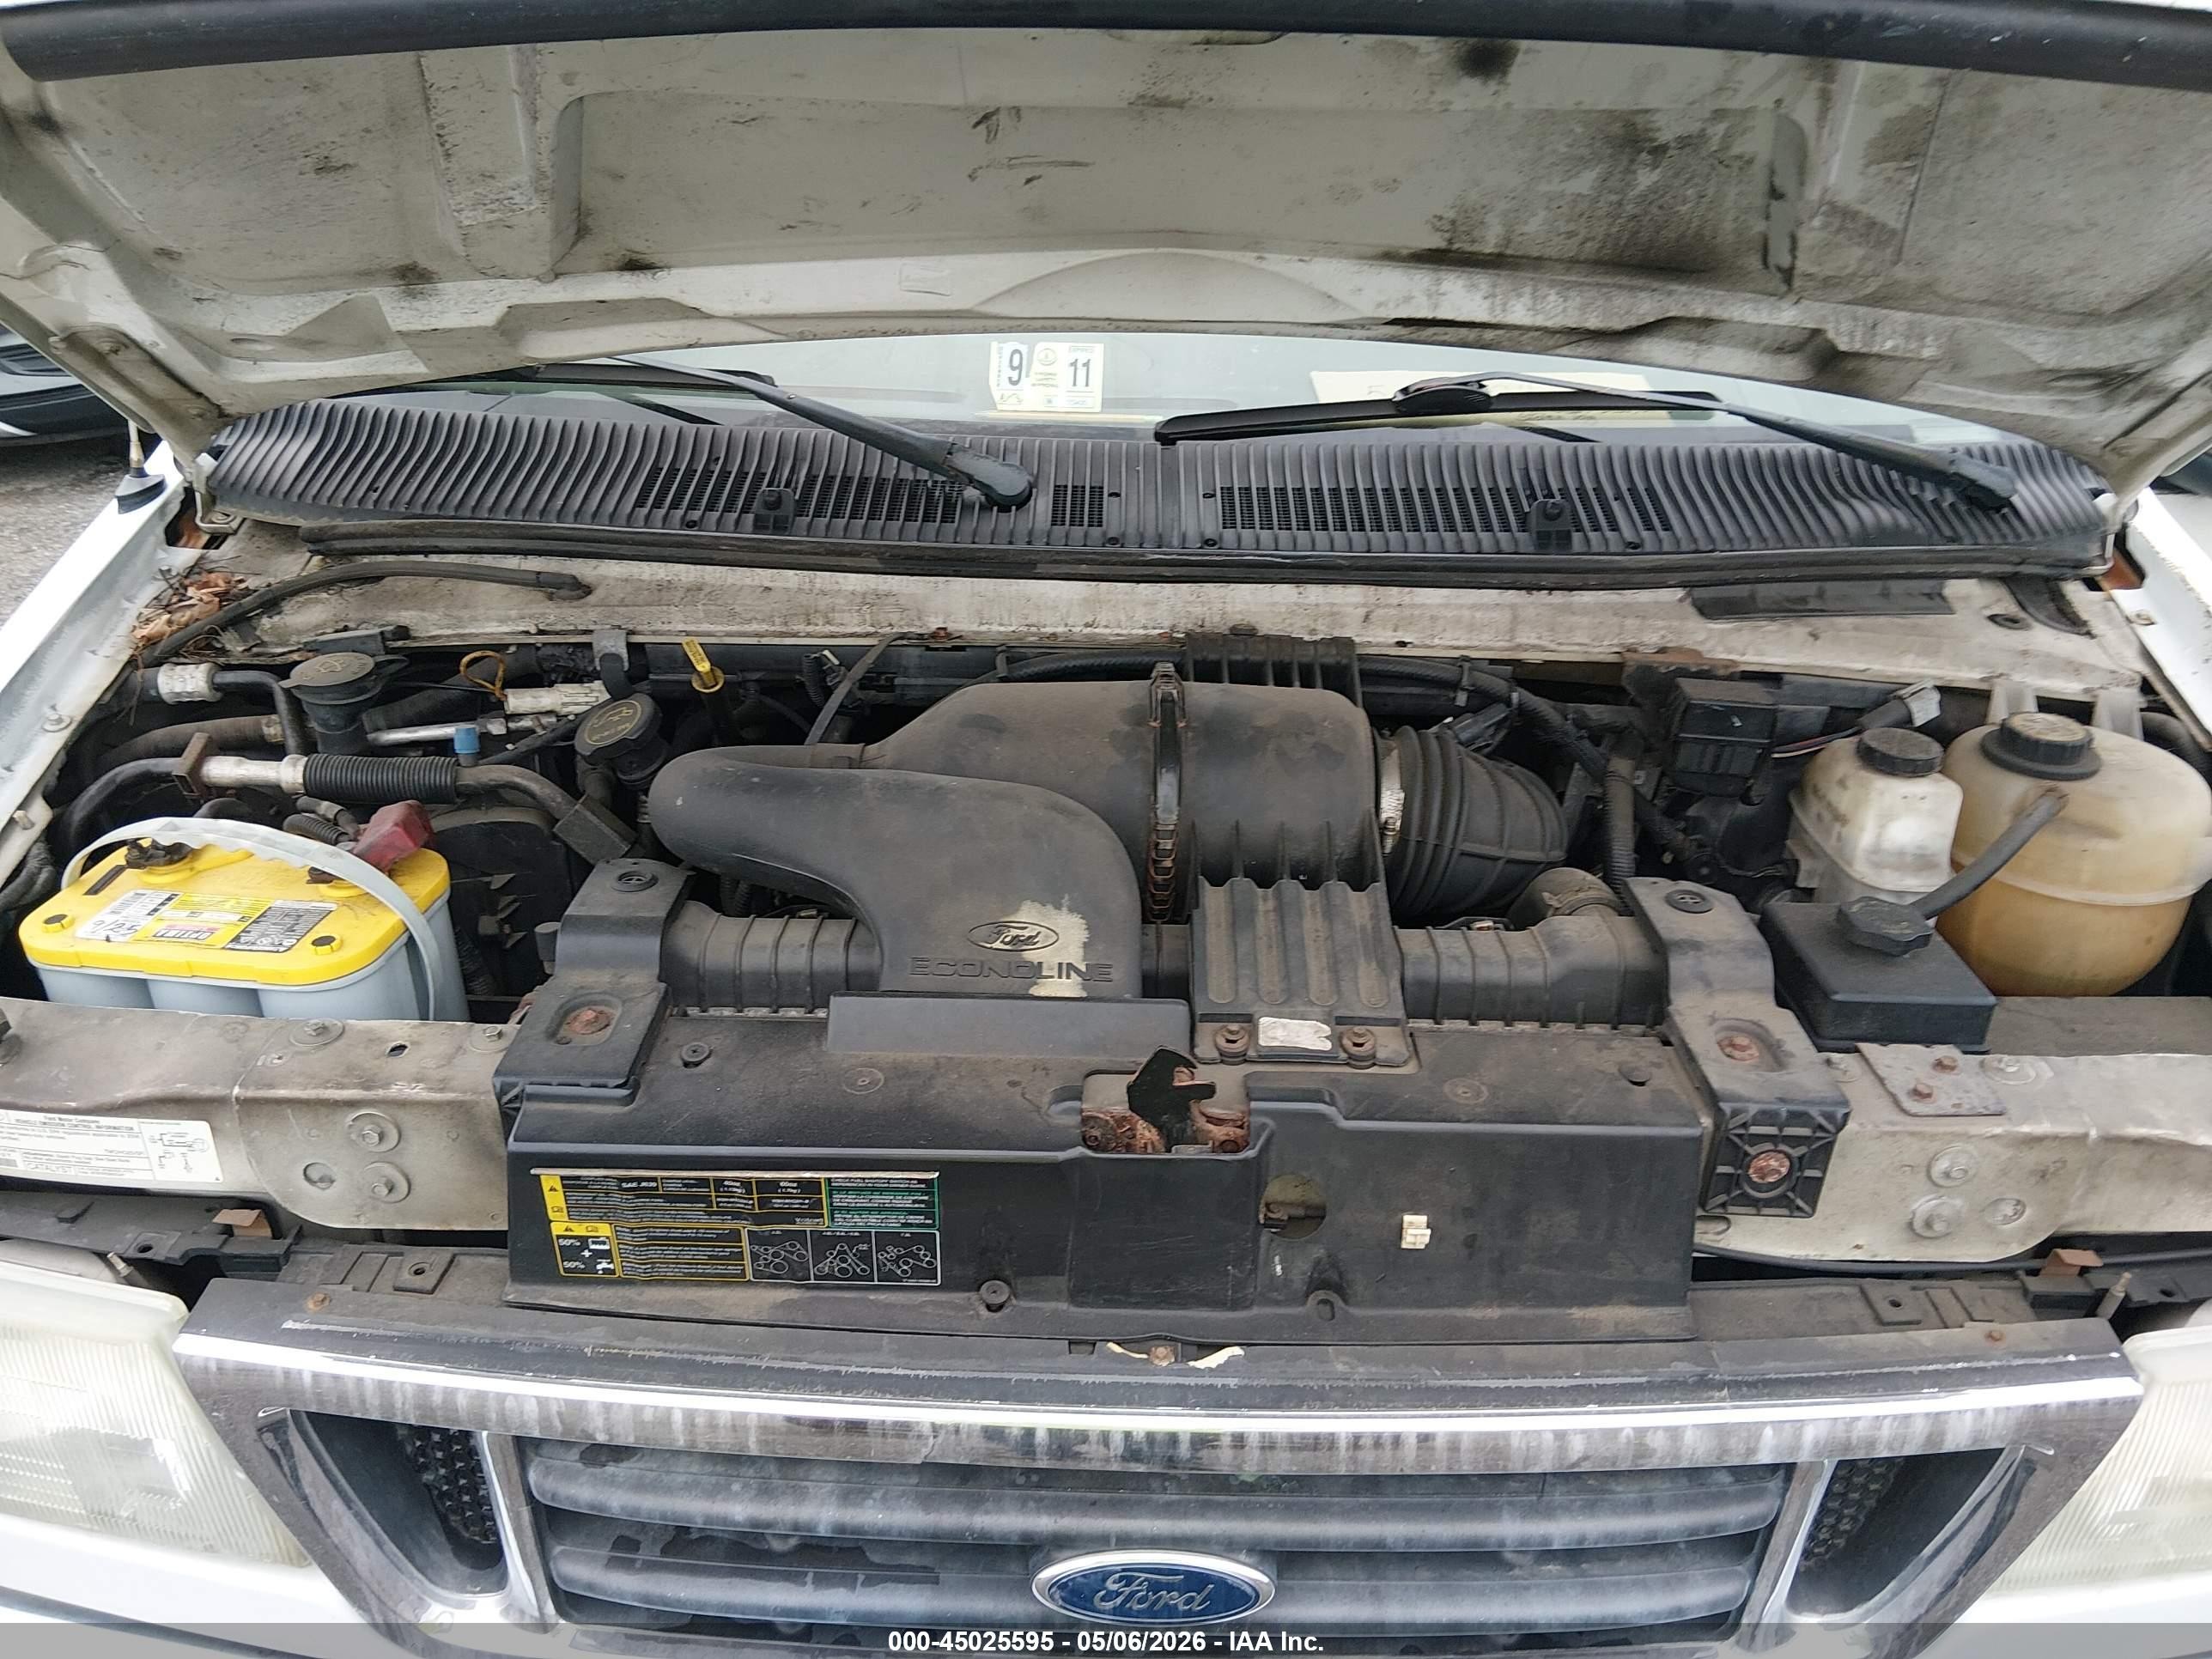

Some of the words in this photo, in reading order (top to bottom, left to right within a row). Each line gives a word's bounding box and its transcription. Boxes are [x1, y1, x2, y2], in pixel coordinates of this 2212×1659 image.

[1008, 349, 1024, 386] 9
[1068, 358, 1091, 387] 11
[988, 925, 1042, 945] Ford
[908, 957, 1114, 982] ECONOLINE
[1093, 1571, 1215, 1611] Ford
